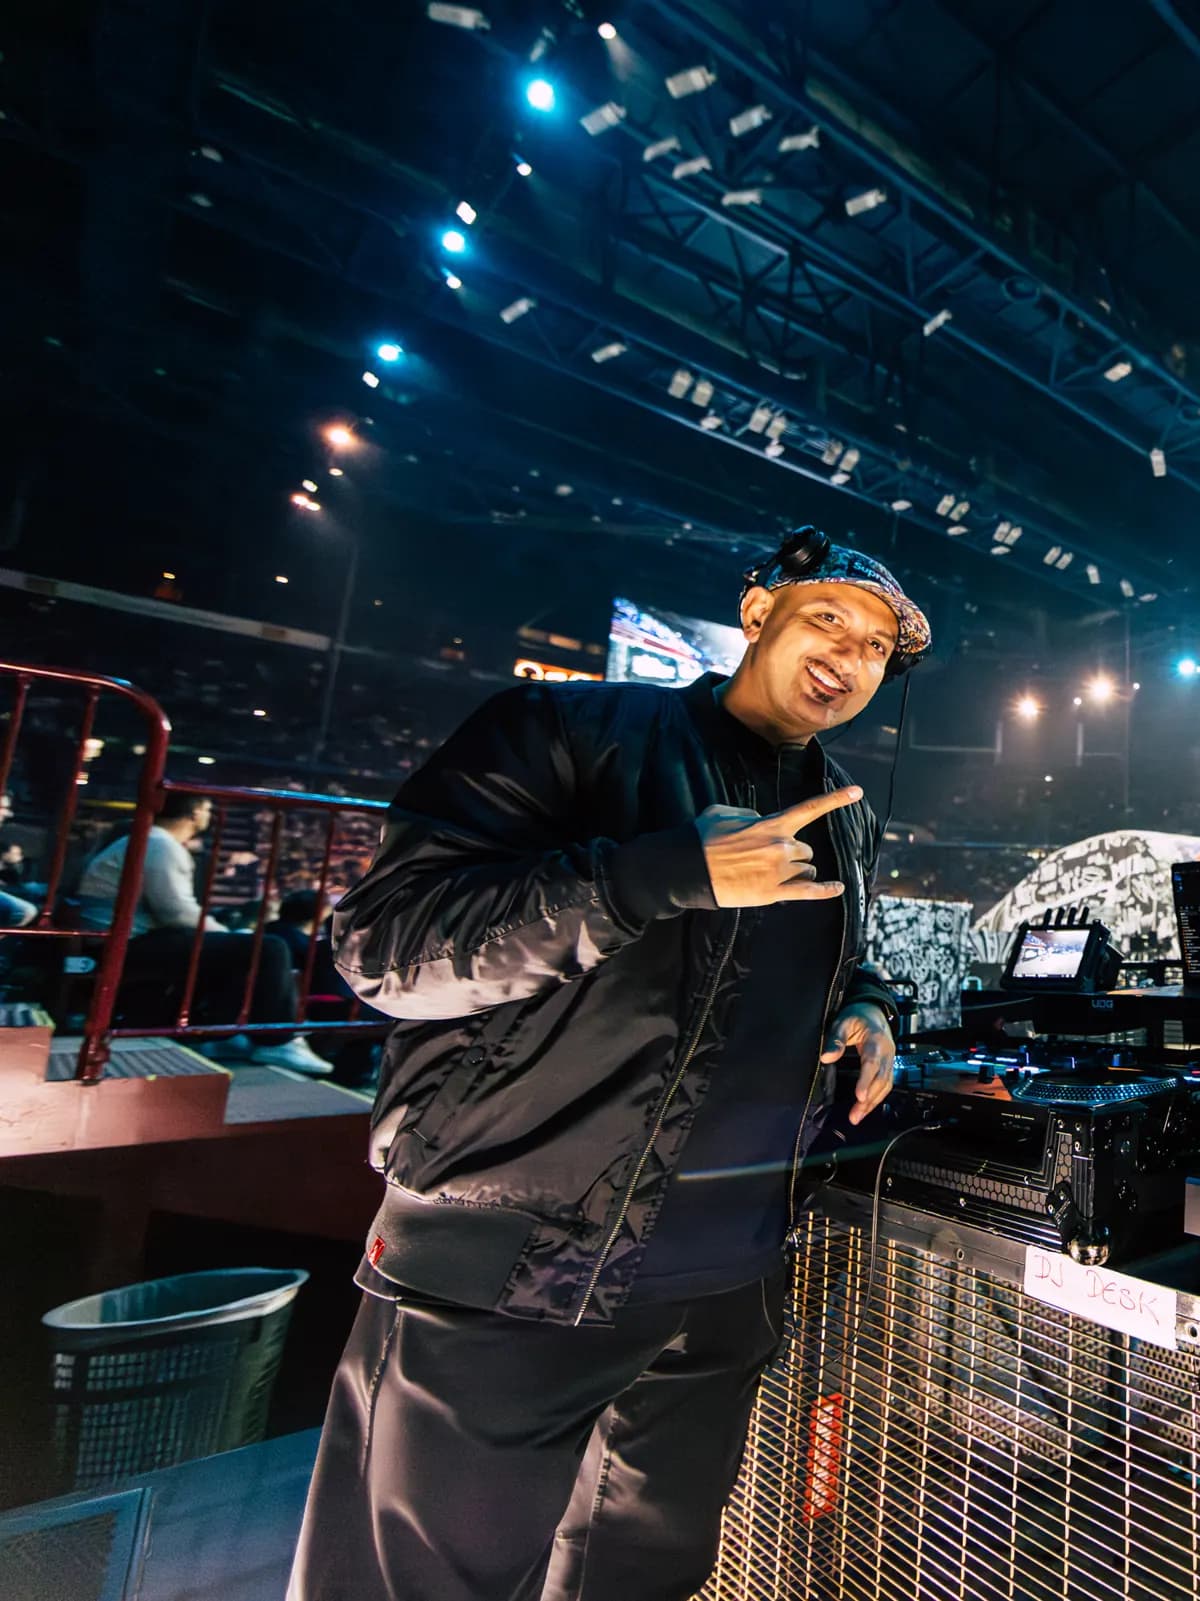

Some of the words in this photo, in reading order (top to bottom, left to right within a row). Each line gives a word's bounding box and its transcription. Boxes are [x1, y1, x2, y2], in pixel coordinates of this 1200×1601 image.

[1091, 999, 1114, 1009] UDG
[1033, 1254, 1064, 1288] DJ
[1086, 1269, 1160, 1326] DESK
